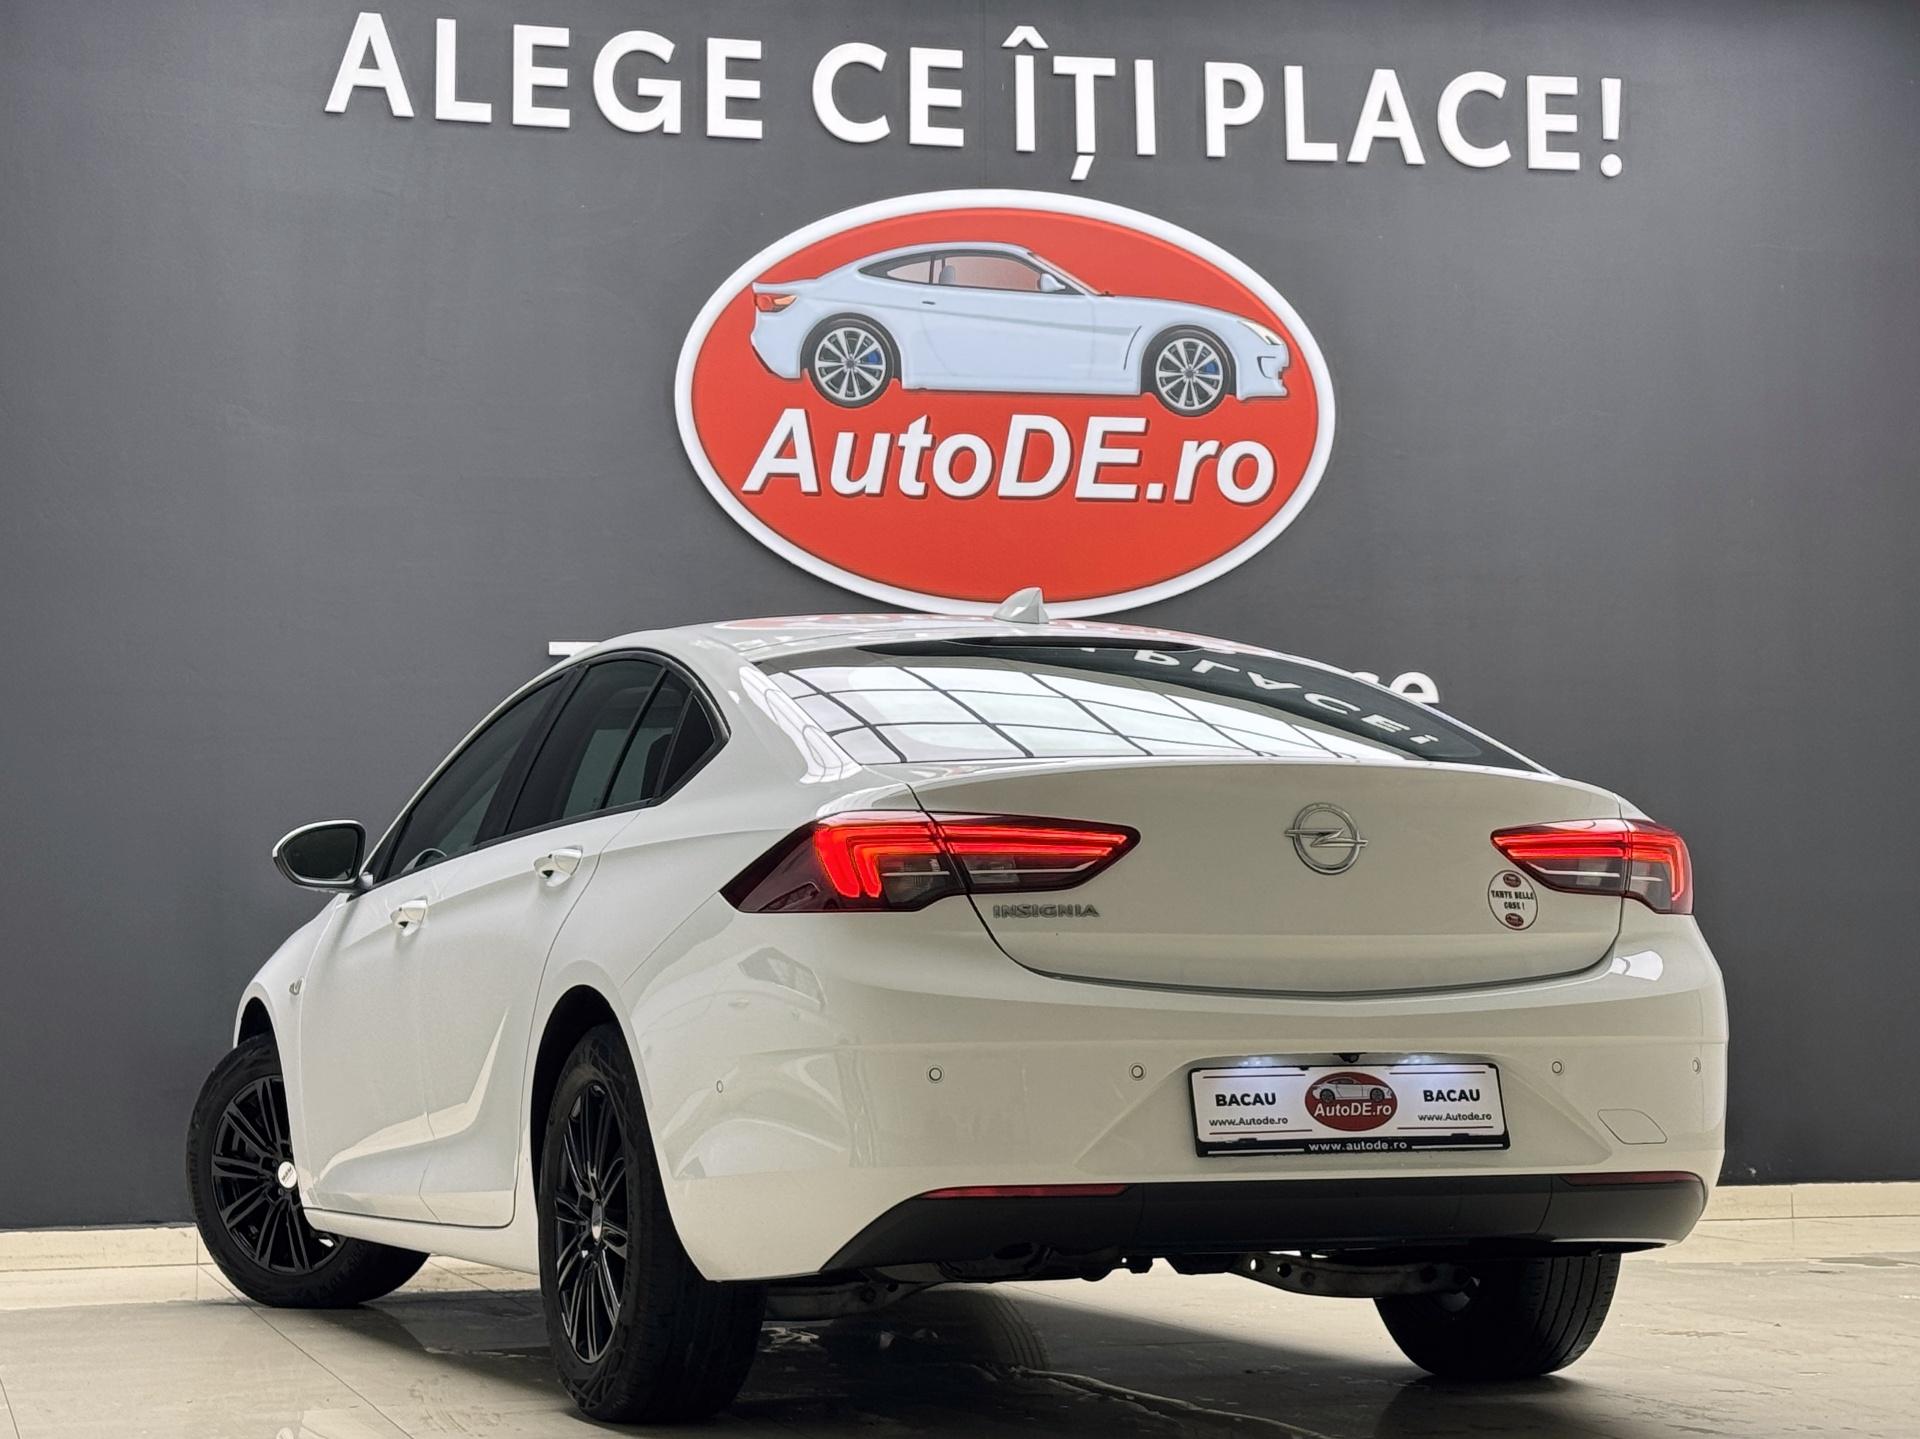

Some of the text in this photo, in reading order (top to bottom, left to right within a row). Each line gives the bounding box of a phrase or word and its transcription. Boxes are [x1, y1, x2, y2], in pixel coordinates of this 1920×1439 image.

[325, 12, 1622, 180] ALEGE CE ÎȚI PLACE!
[741, 408, 1277, 503] AutoDE.ro
[993, 904, 1100, 918] INSIGNIA
[1215, 1092, 1276, 1107] BACAU
[1423, 1089, 1481, 1103] BACAU
[1314, 1102, 1392, 1117] AutoDE.ro
[1209, 1116, 1289, 1127] www.Autode.ro
[1418, 1112, 1492, 1122] www.Autode.ro
[1308, 1139, 1408, 1151] www.autode.ro
